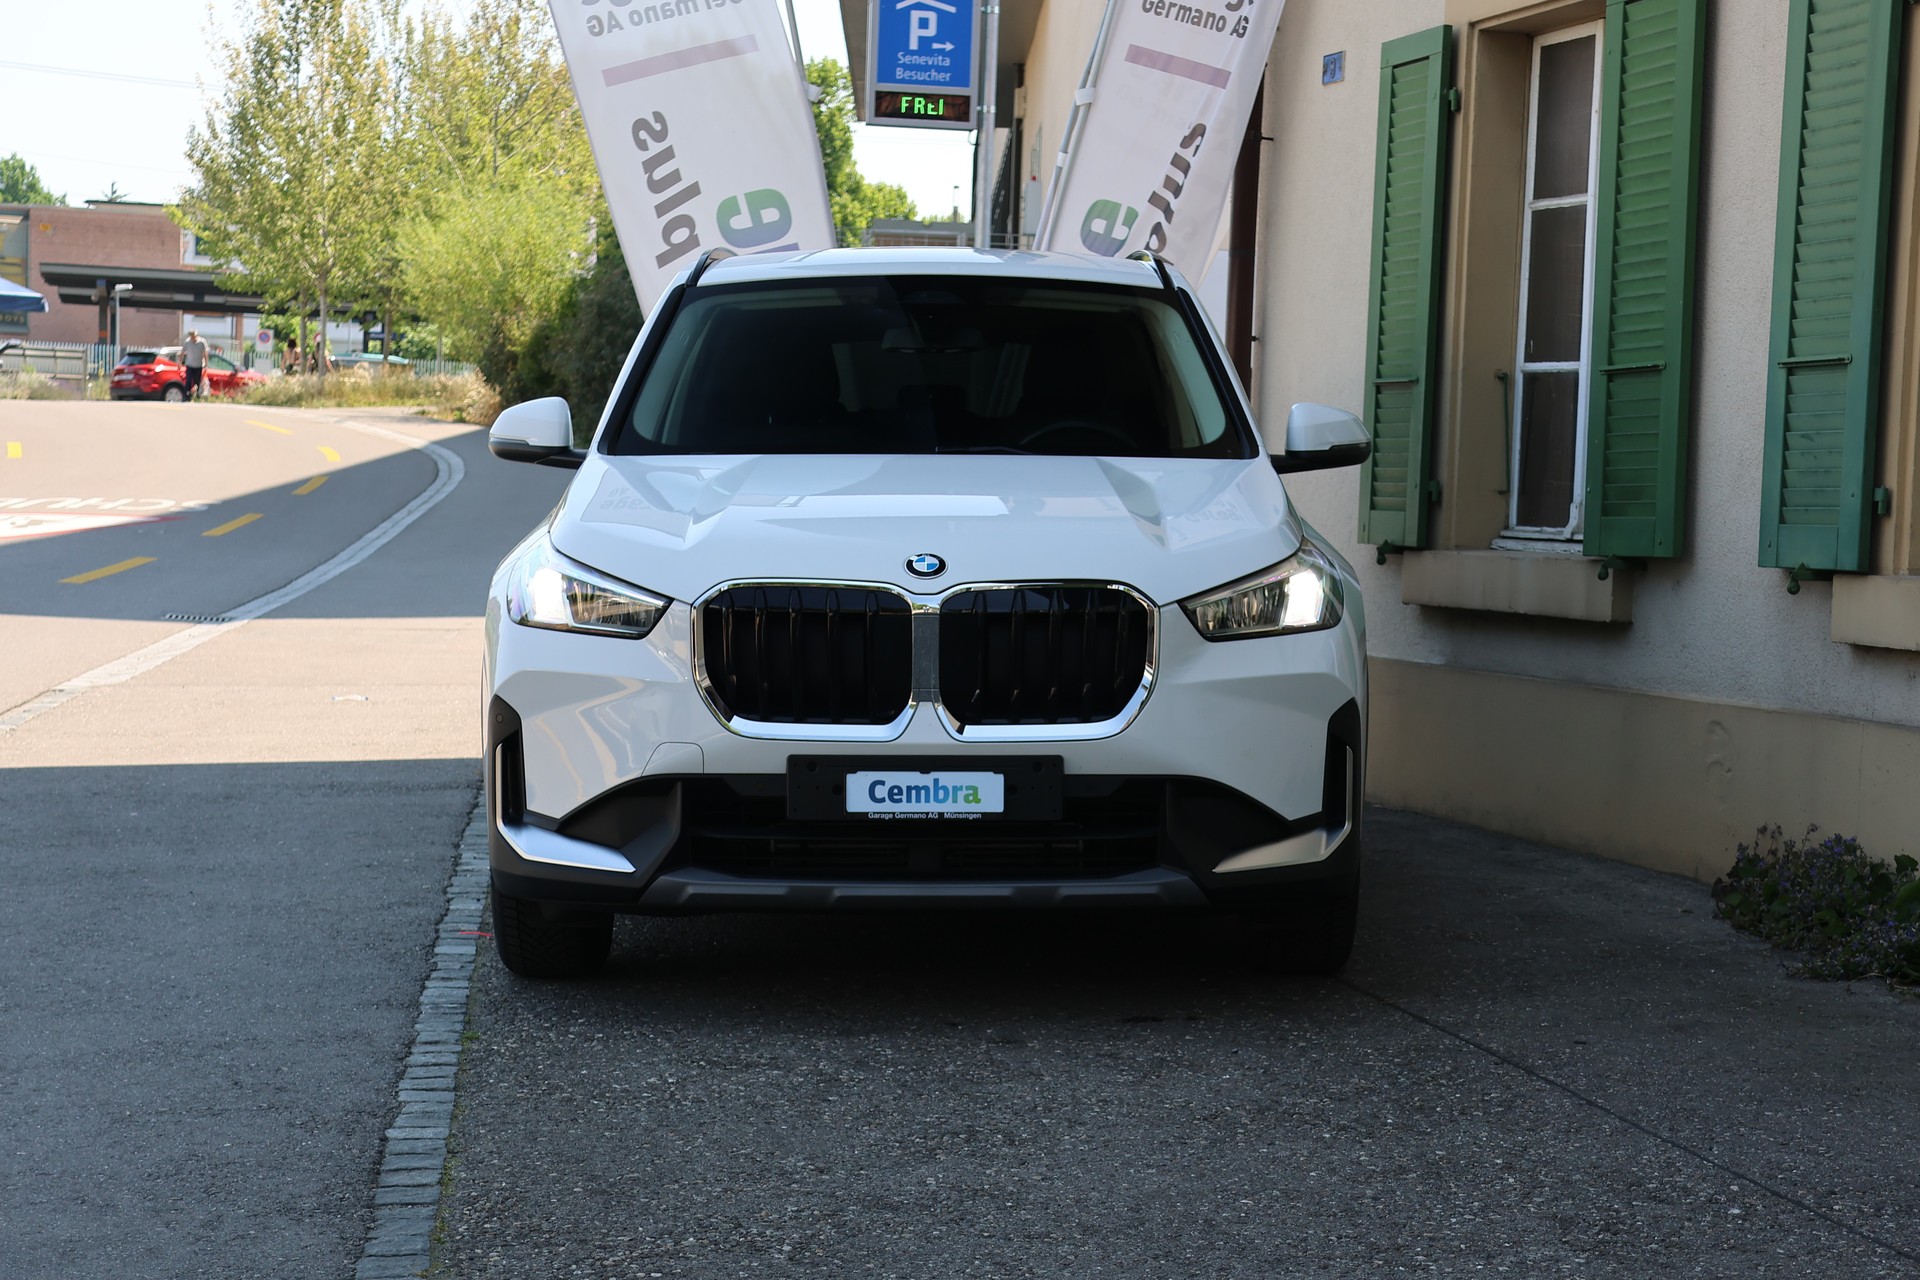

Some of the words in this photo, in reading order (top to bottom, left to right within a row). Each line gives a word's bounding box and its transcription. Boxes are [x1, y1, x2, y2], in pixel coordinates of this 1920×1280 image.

[909, 10, 938, 51] P
[1229, 14, 1249, 39] AG
[897, 51, 951, 67] Senevita
[895, 67, 952, 82] Besucher
[868, 778, 981, 804] Cembra
[868, 811, 893, 820] Garage
[895, 811, 926, 819] Germano
[928, 811, 938, 819] AG
[944, 811, 981, 820] Münsingen
